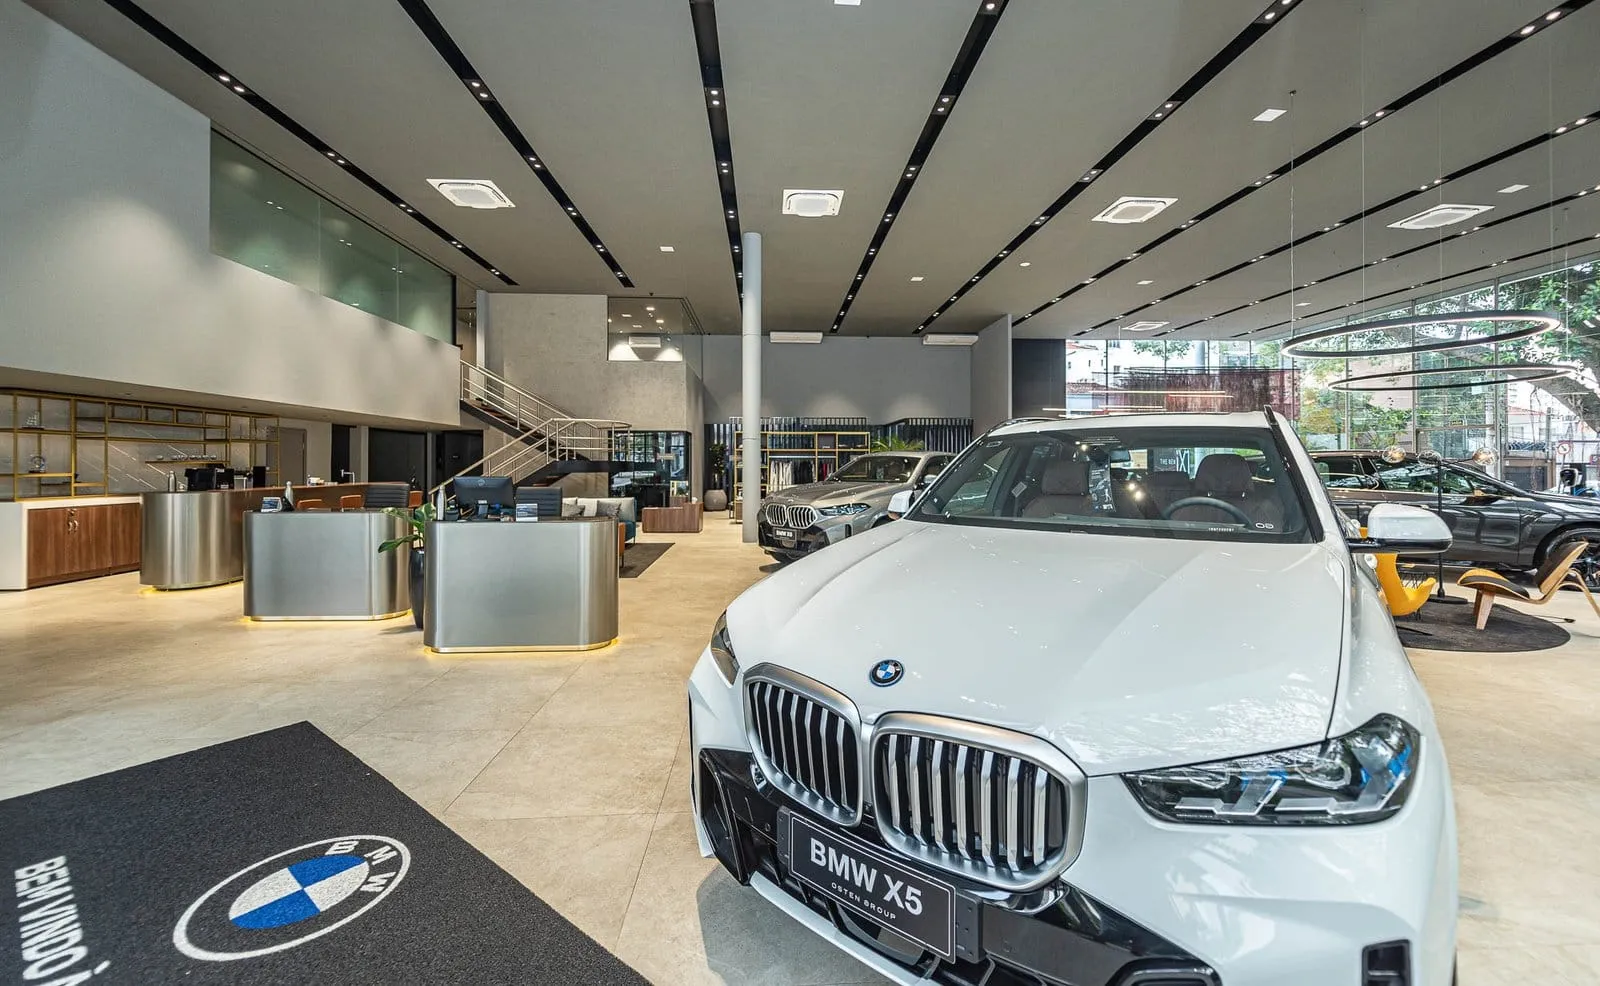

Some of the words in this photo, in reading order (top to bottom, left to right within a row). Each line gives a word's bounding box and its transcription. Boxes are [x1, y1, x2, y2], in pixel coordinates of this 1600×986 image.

[15, 855, 73, 908] BEM
[324, 840, 398, 892] BMW
[810, 837, 878, 893] BMW
[883, 873, 923, 916] X5
[831, 882, 861, 903] OSTEN
[863, 900, 897, 919] GROUP
[18, 893, 88, 980] VINDO
